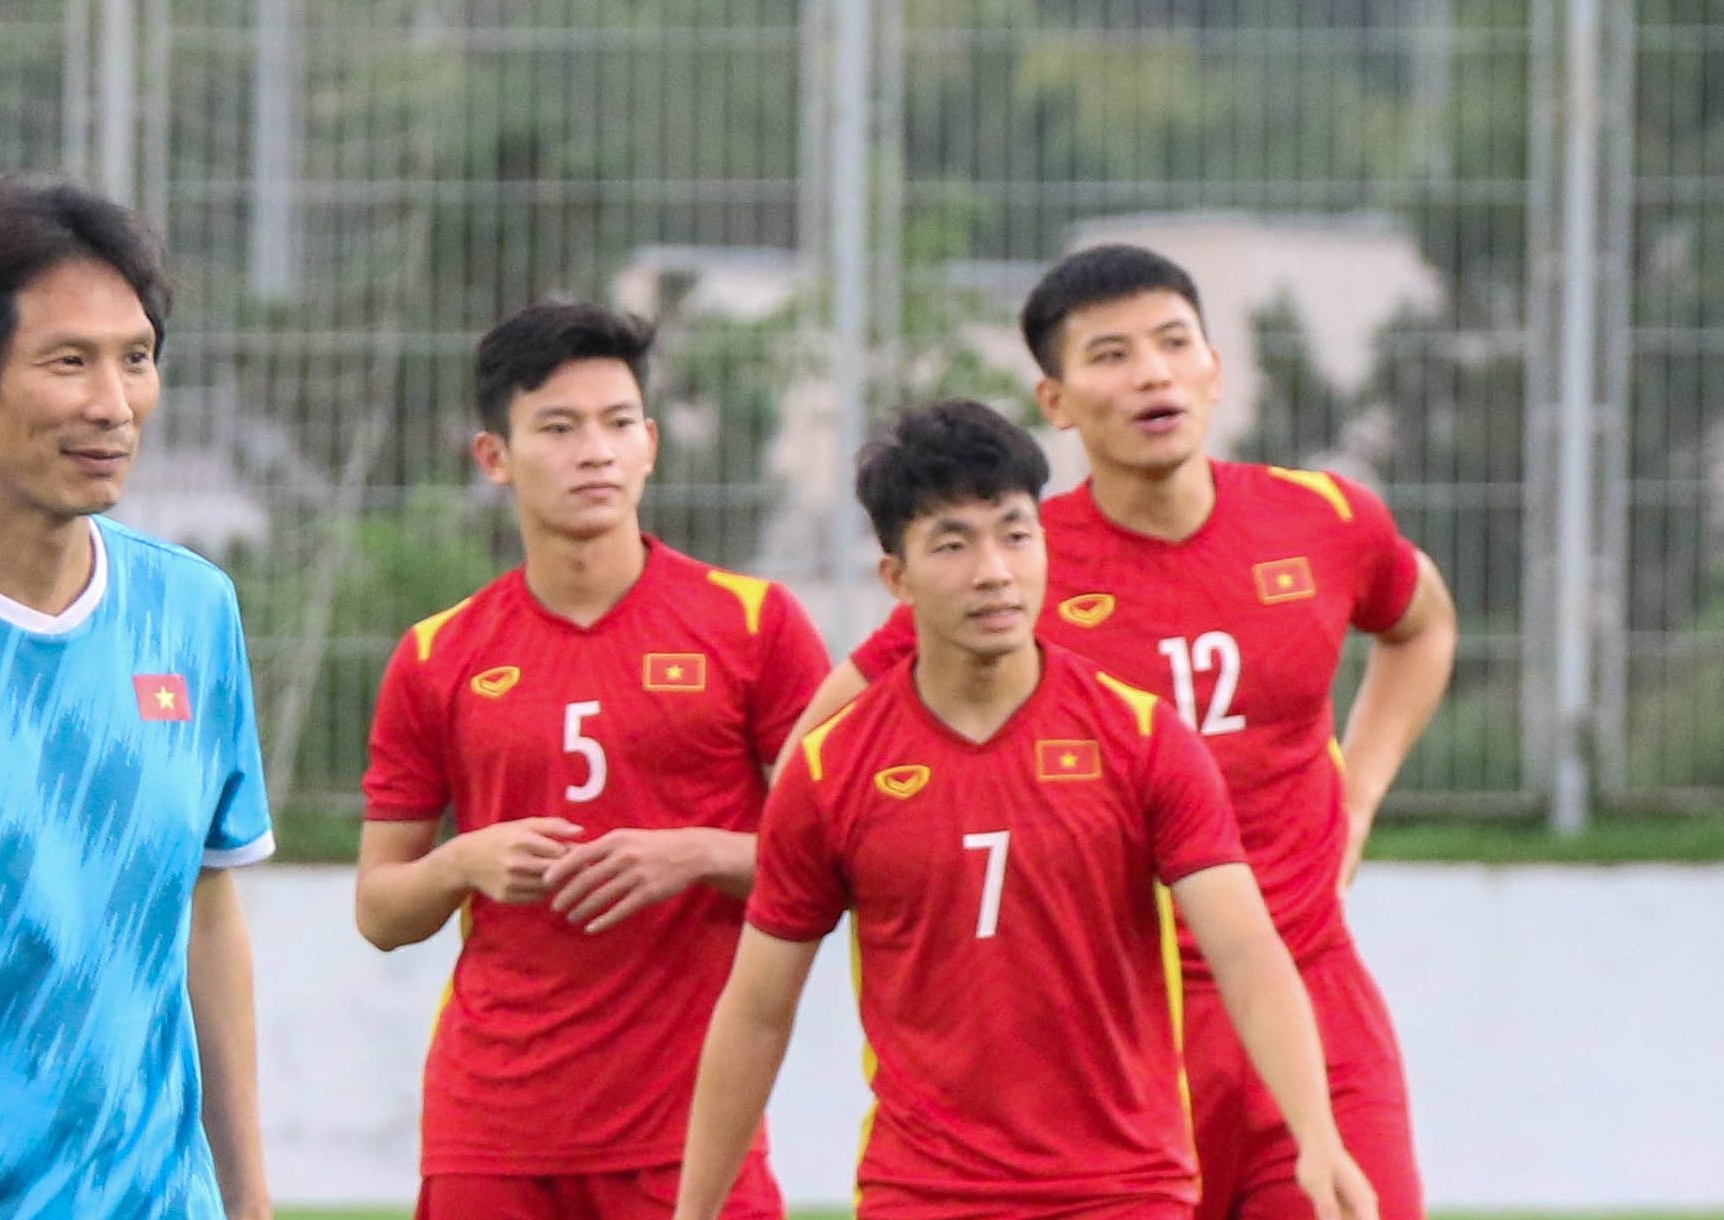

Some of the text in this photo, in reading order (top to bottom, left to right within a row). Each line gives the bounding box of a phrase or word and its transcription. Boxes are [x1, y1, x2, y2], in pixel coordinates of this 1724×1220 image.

[1158, 631, 1246, 736] 12
[563, 700, 607, 802] 5
[962, 831, 1011, 939] 7
